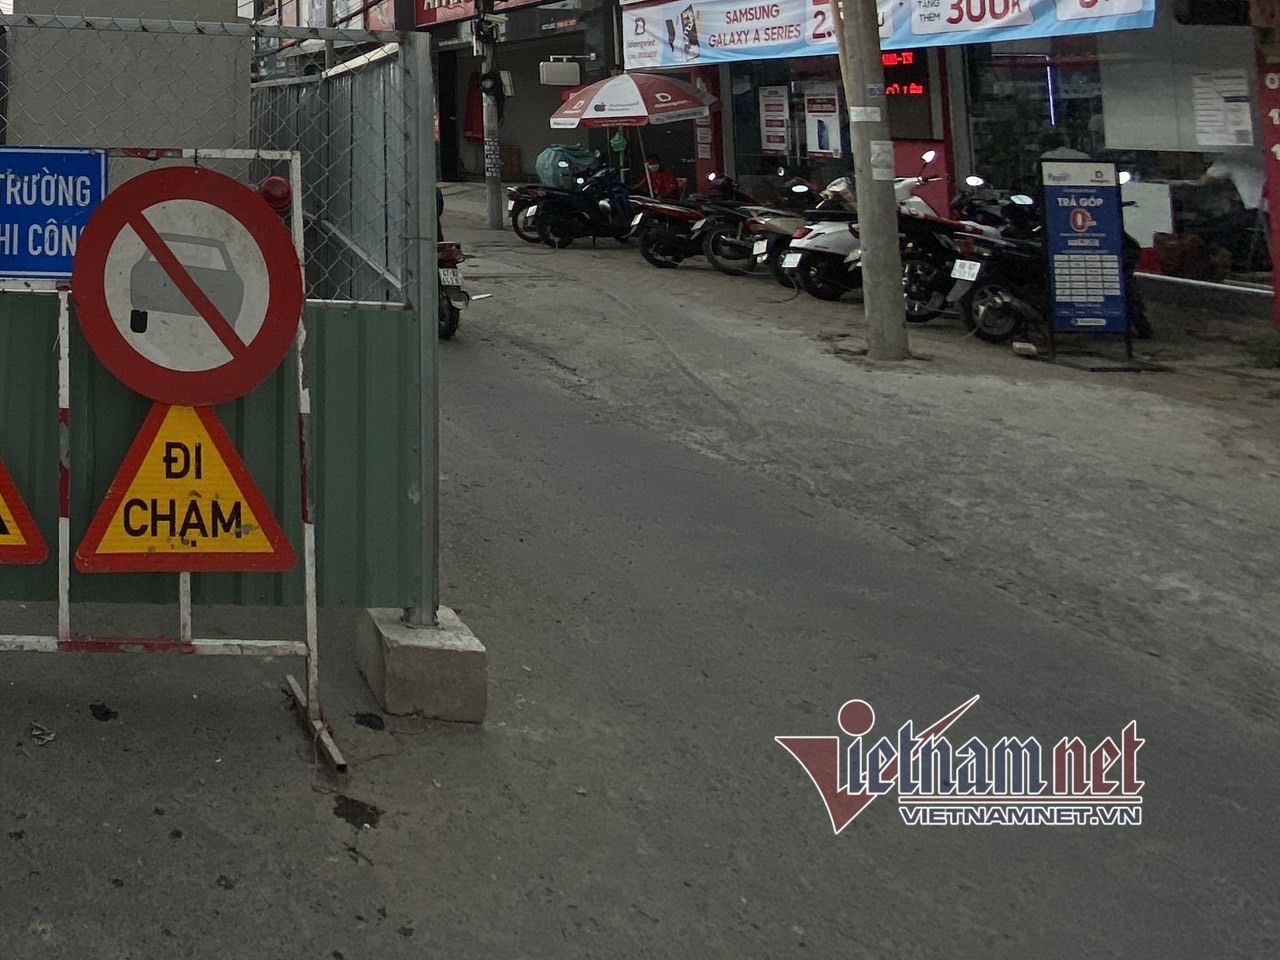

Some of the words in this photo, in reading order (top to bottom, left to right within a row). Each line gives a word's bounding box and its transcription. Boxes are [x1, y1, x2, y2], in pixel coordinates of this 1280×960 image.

[725, 3, 781, 25] SAMSUNG
[708, 28, 751, 49] GALAXY
[753, 28, 761, 42] A
[763, 23, 802, 43] SERIES
[1079, 194, 1104, 208] GÓP
[27, 218, 87, 257] CÔN
[163, 441, 202, 480] ĐI
[123, 490, 243, 548] CHẬM
